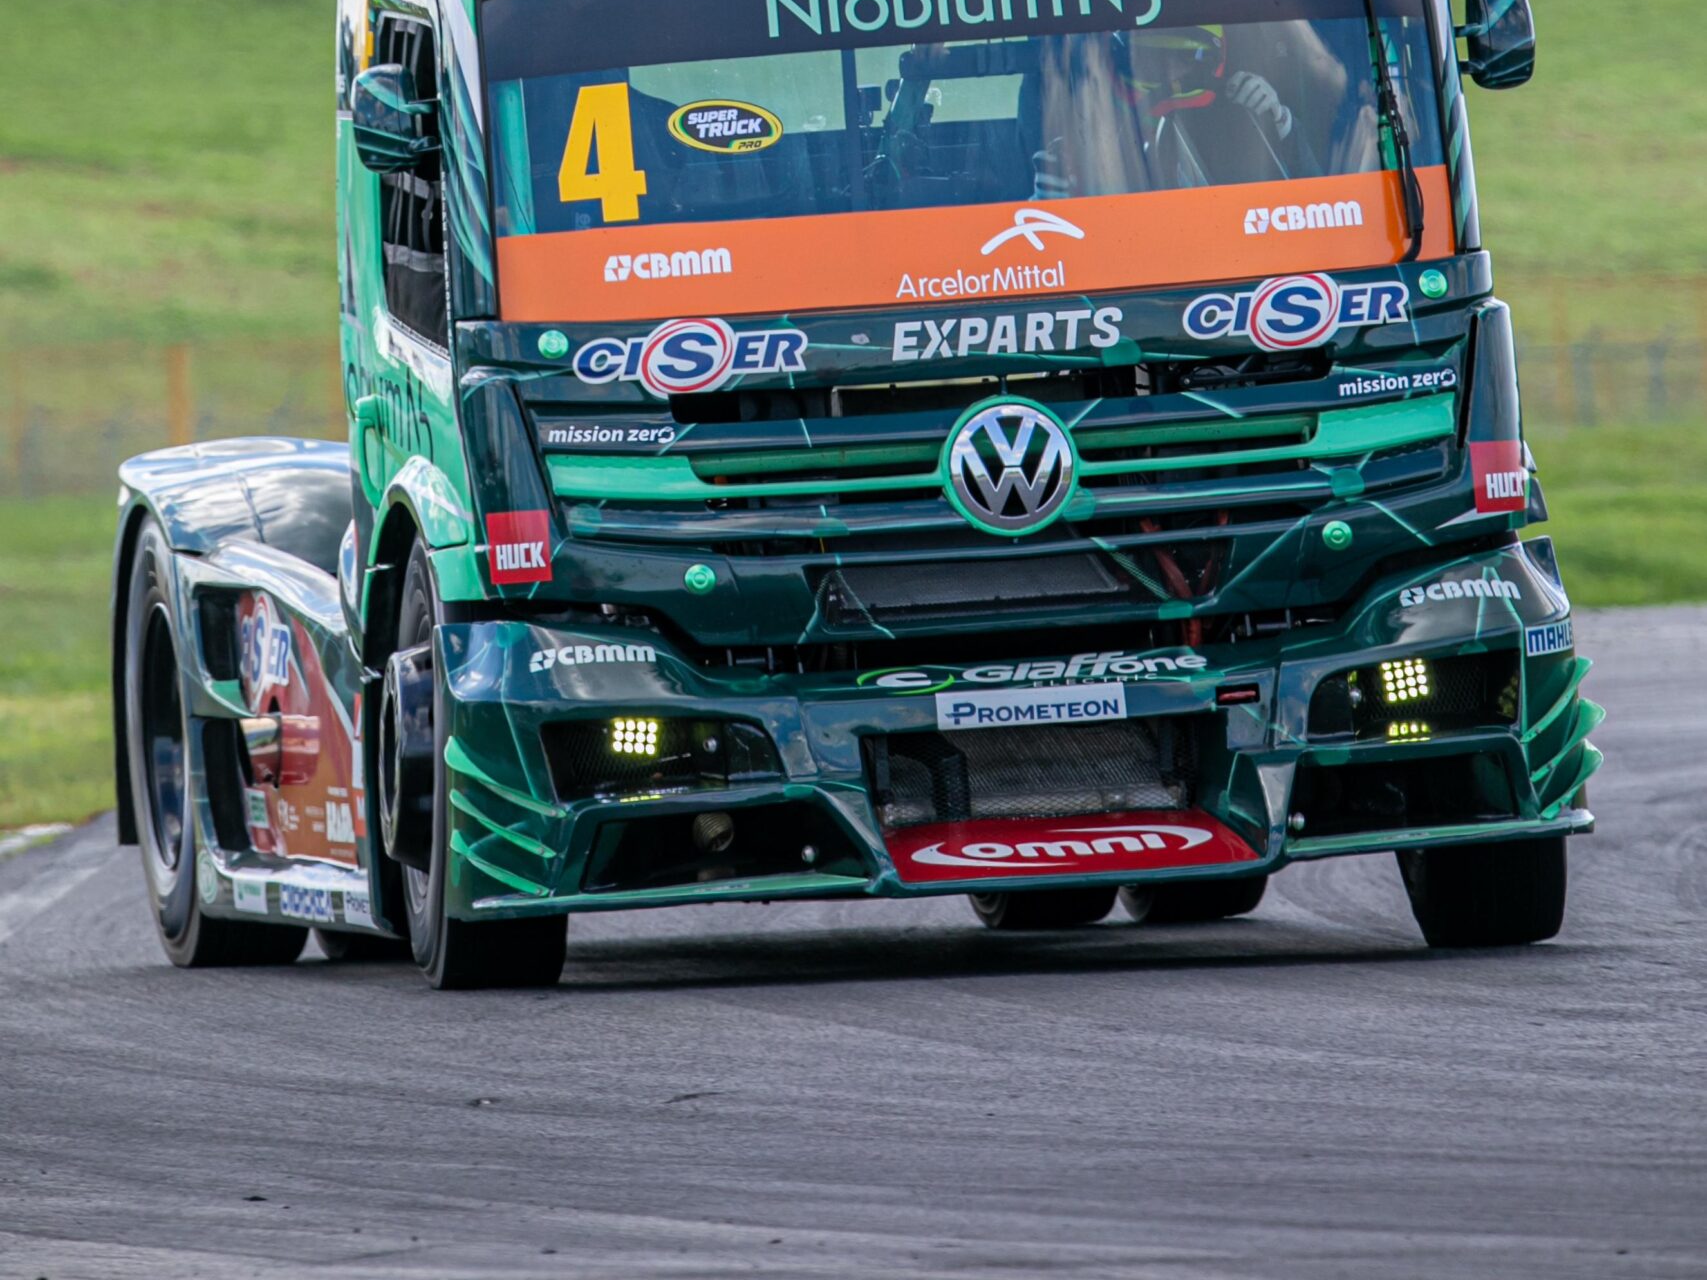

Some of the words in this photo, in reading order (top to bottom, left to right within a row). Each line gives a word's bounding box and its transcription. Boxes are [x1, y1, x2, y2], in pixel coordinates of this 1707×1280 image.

[688, 109, 738, 125] SUPER
[696, 118, 763, 138] TRUCK
[558, 82, 647, 222] 4
[738, 140, 762, 150] PRO
[896, 261, 1065, 298] ArcelorMittal
[1184, 277, 1407, 342] CISER
[892, 307, 1123, 361] EXPARTS
[574, 326, 807, 385] CISER
[1339, 375, 1409, 396] mission
[1412, 368, 1456, 388] zero
[548, 425, 624, 442] mission
[627, 426, 675, 444] zero
[1486, 471, 1525, 499] HUCK
[495, 542, 546, 570] HUCK
[1528, 622, 1573, 653] MAHLE
[962, 651, 1208, 682] Giaffone
[1033, 673, 1158, 687] ELECTRIC
[961, 833, 1167, 860] omni
